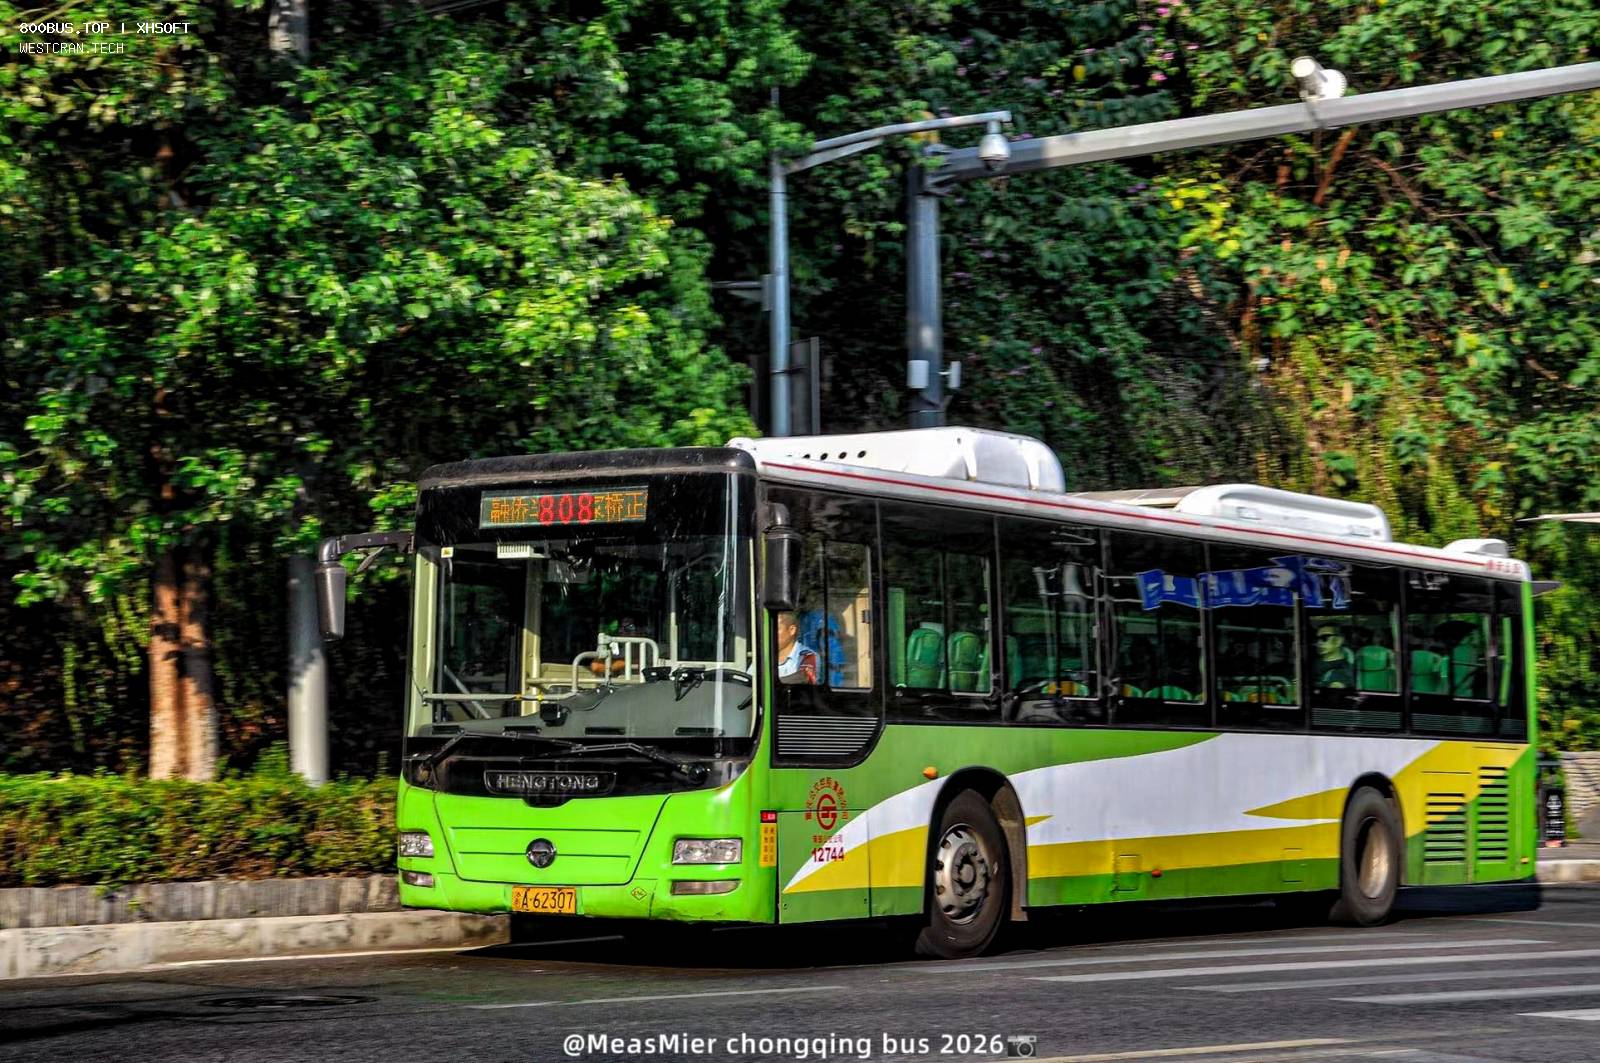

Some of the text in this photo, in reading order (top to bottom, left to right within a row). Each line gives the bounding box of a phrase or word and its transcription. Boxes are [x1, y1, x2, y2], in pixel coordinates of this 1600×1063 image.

[539, 493, 595, 525] 808
[496, 774, 599, 789] HENGTONG
[811, 847, 845, 862] 12744
